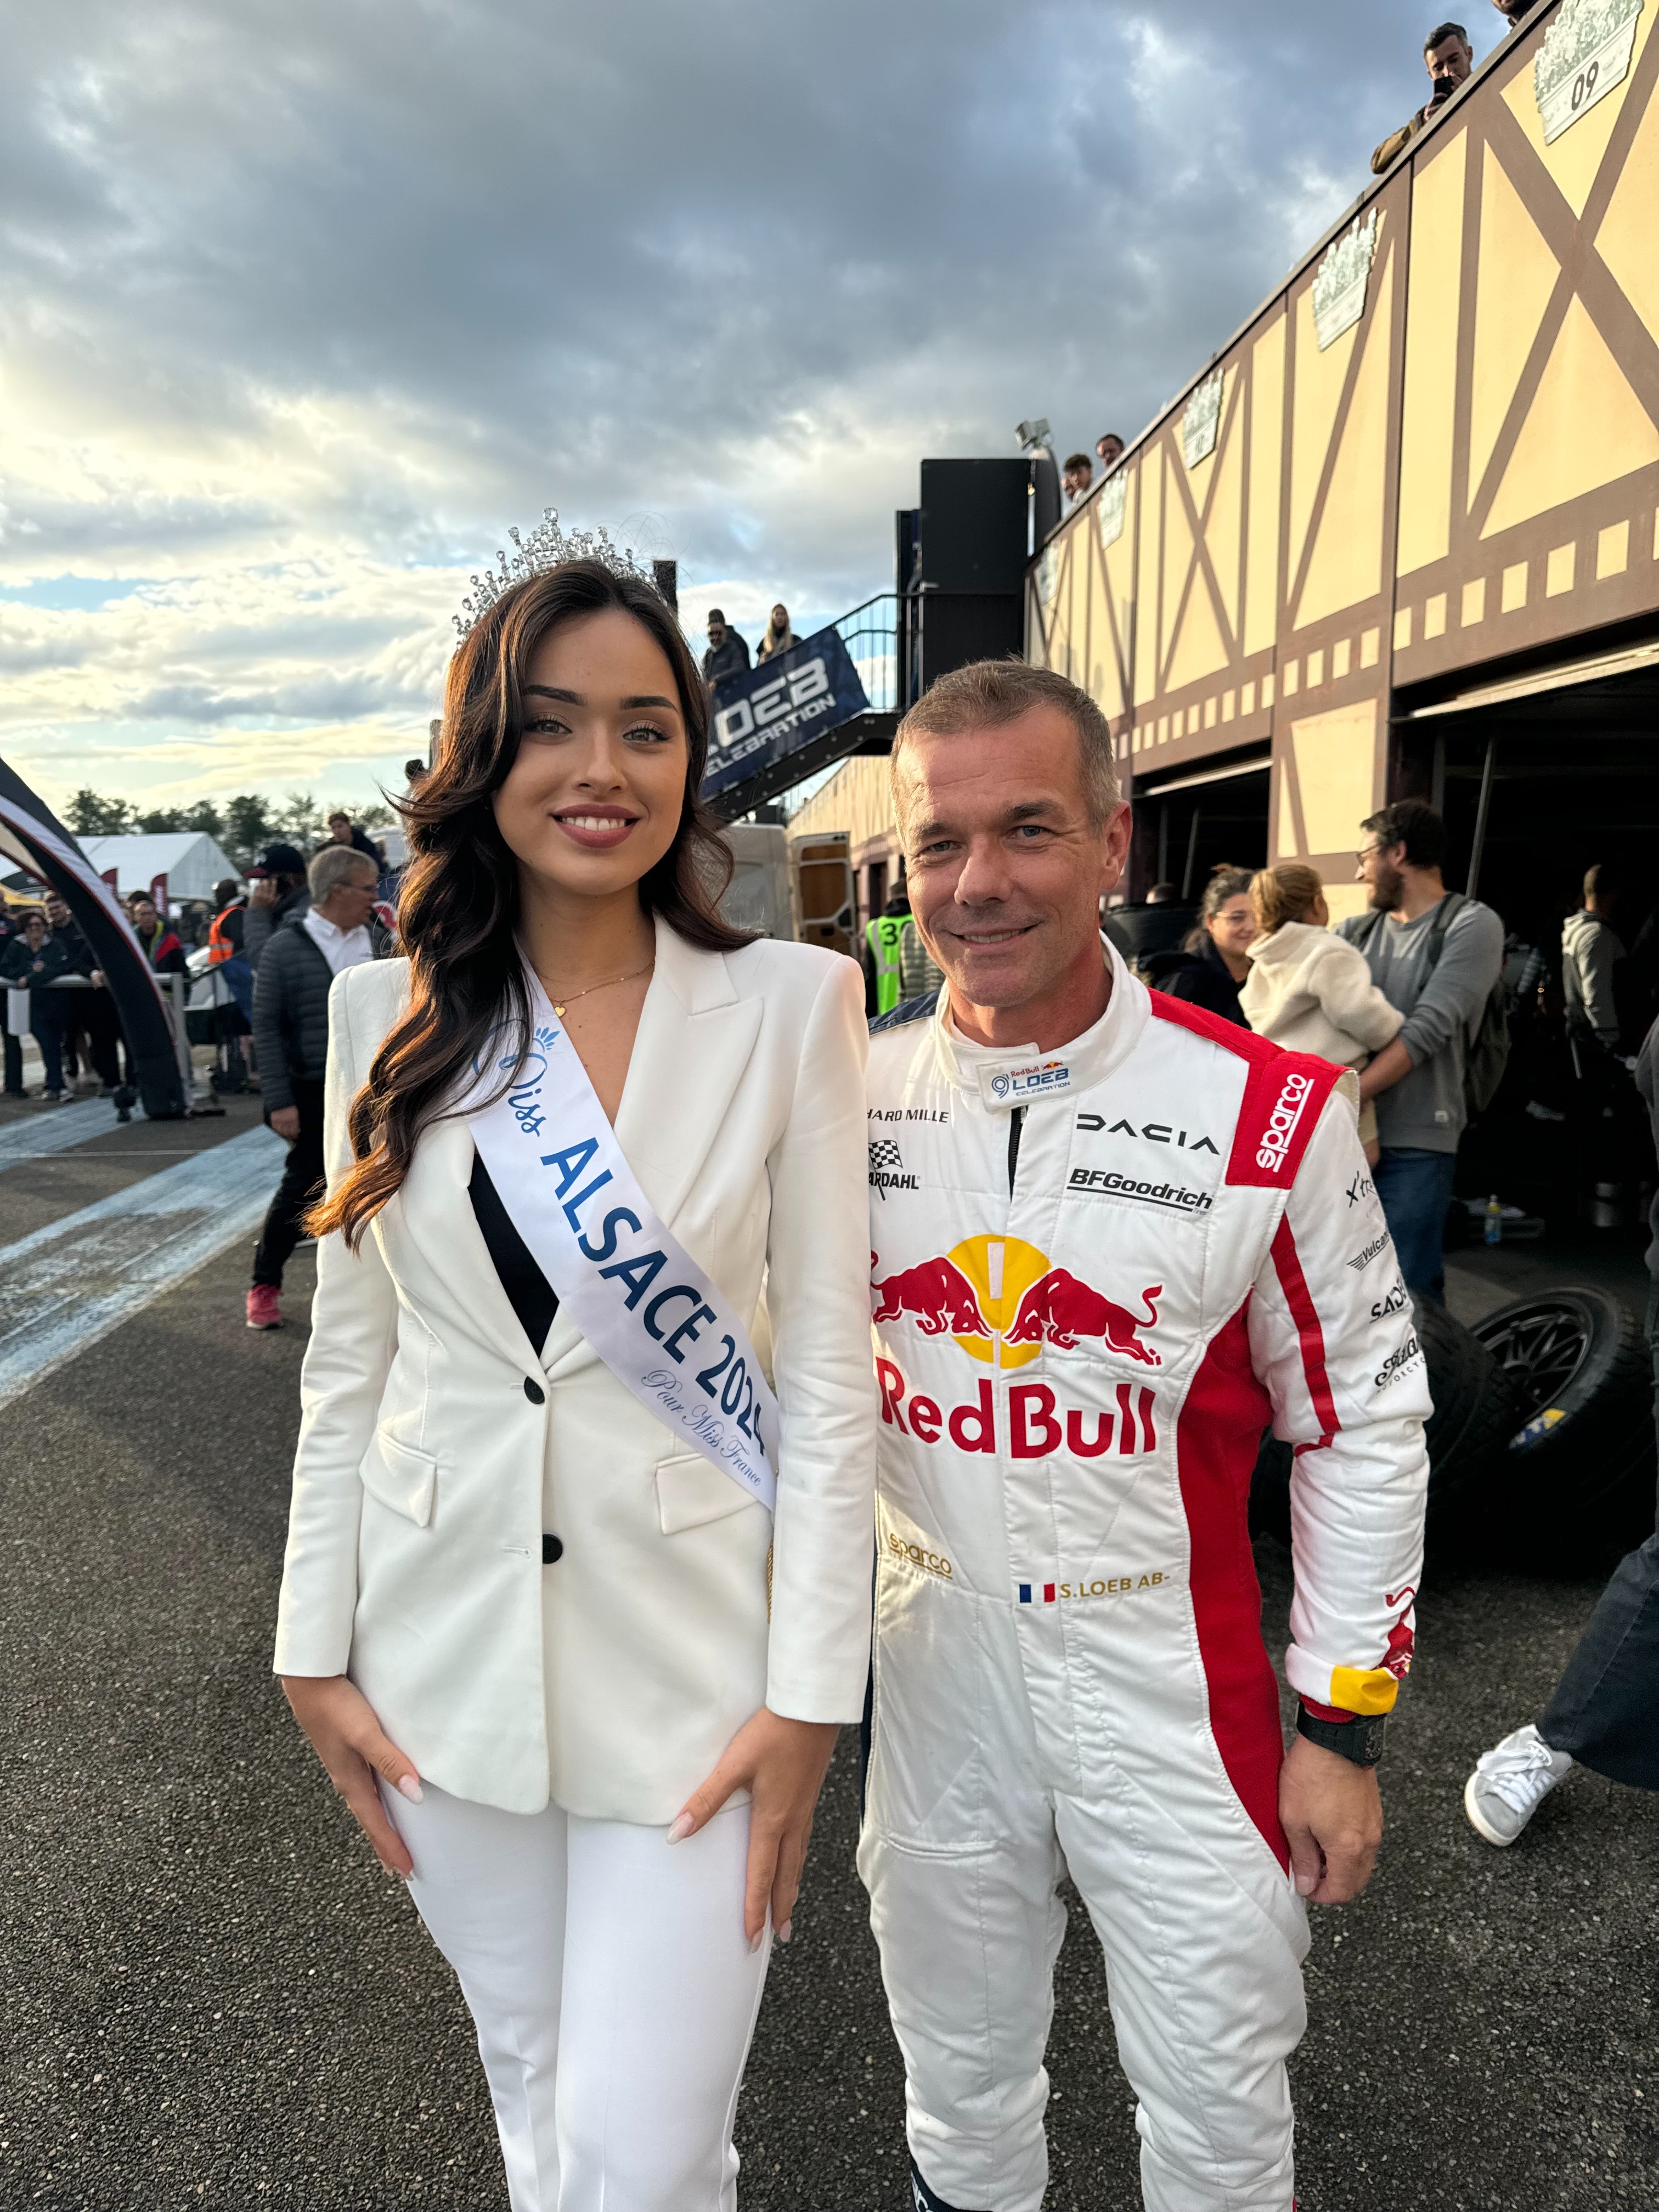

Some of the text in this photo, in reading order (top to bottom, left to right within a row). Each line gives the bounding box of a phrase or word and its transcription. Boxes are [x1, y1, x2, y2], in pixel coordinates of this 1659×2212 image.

[1571, 61, 1599, 111] 09
[708, 656, 829, 756] OEB
[1010, 1065, 1040, 1077] Red Bull
[1012, 1068, 1069, 1091] LOEB
[1015, 1081, 1070, 1096] CELEBRATION
[905, 1109, 950, 1123] MILLE
[1076, 1114, 1221, 1156] DACIA
[1255, 1074, 1308, 1170] sparco
[1069, 1168, 1213, 1210] BFGoodrich
[540, 1137, 765, 1457] ALSACE 2024
[641, 1369, 761, 1486] Pour Miss France
[876, 1356, 1156, 1459] Red Bull
[890, 1533, 952, 1576] sparco
[1060, 1578, 1132, 1598] S.LOEB
